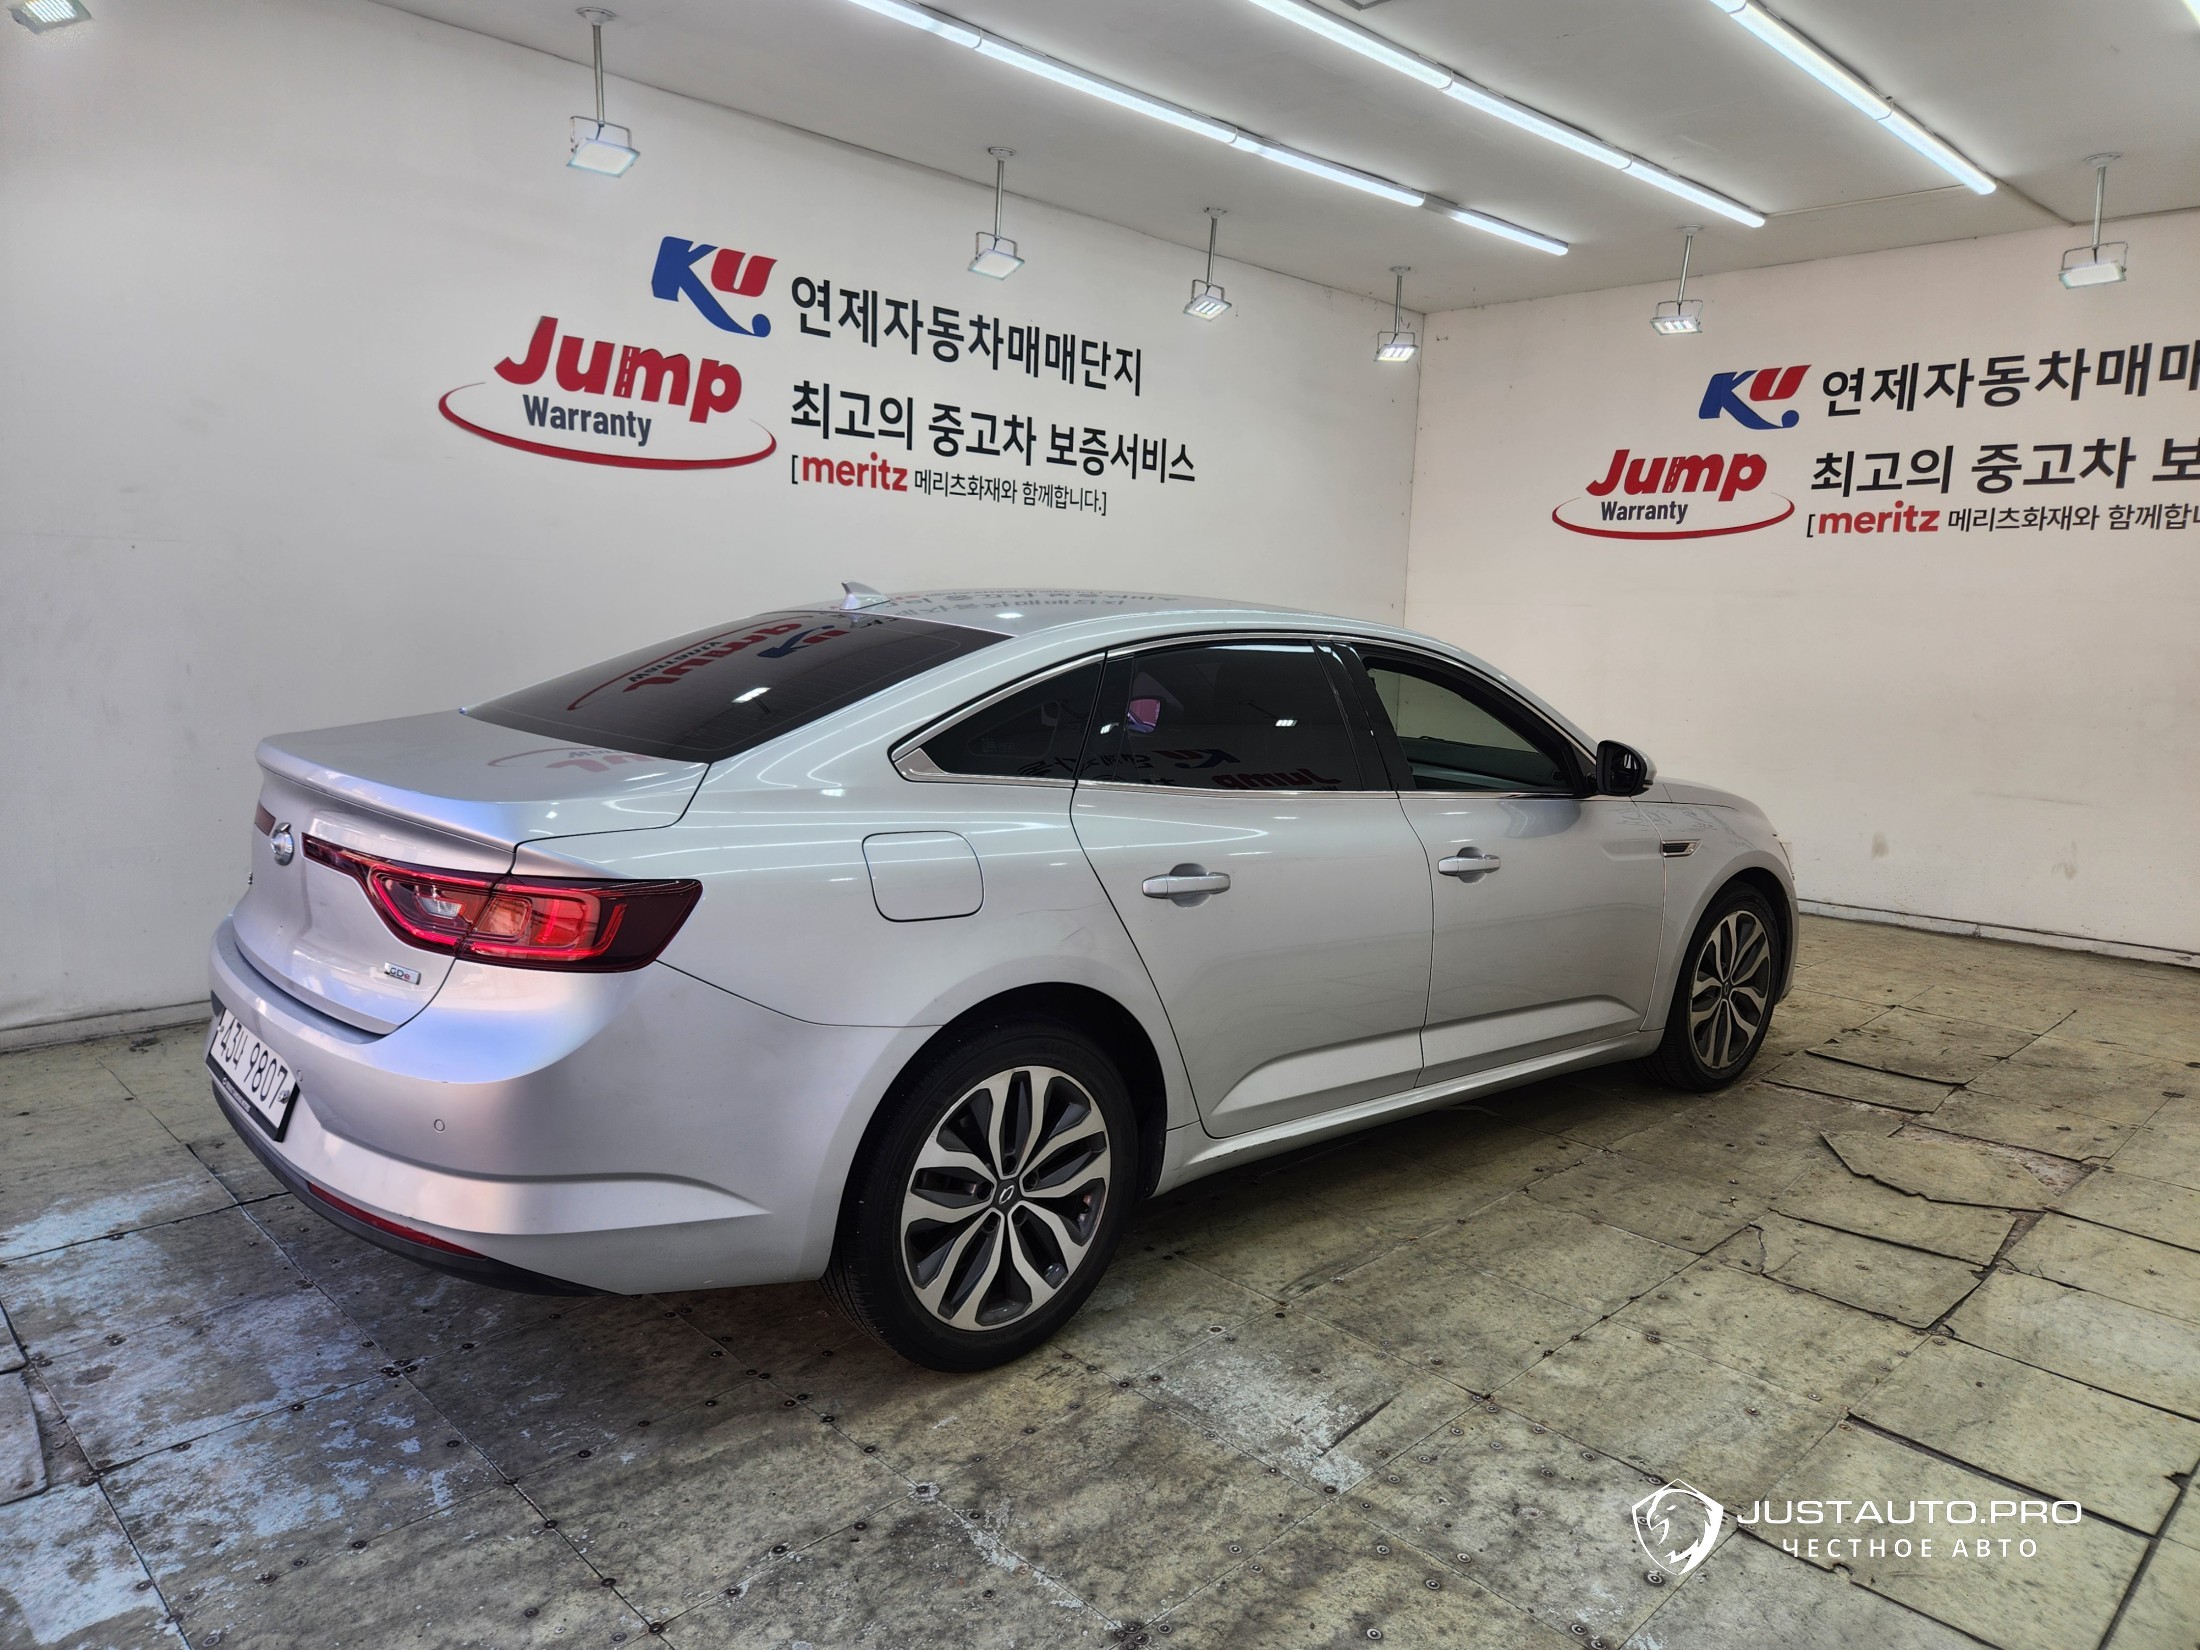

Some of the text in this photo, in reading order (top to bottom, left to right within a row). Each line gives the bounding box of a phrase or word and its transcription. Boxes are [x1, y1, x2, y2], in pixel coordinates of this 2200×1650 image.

[791, 276, 1142, 397] 연제자동차매매단지
[494, 316, 743, 424] Jump
[522, 393, 652, 447] Warranty
[791, 380, 1197, 484] 최고의 중고차 보증서비스
[914, 469, 1018, 505] 메리츠화재와
[1585, 448, 1768, 503] Jump
[1810, 444, 1954, 498] 최고의
[1970, 436, 2137, 494] 중고차
[1600, 500, 1690, 526] Warranty
[1947, 504, 2100, 533] 메리츠화재와
[243, 1041, 289, 1110] 9807
